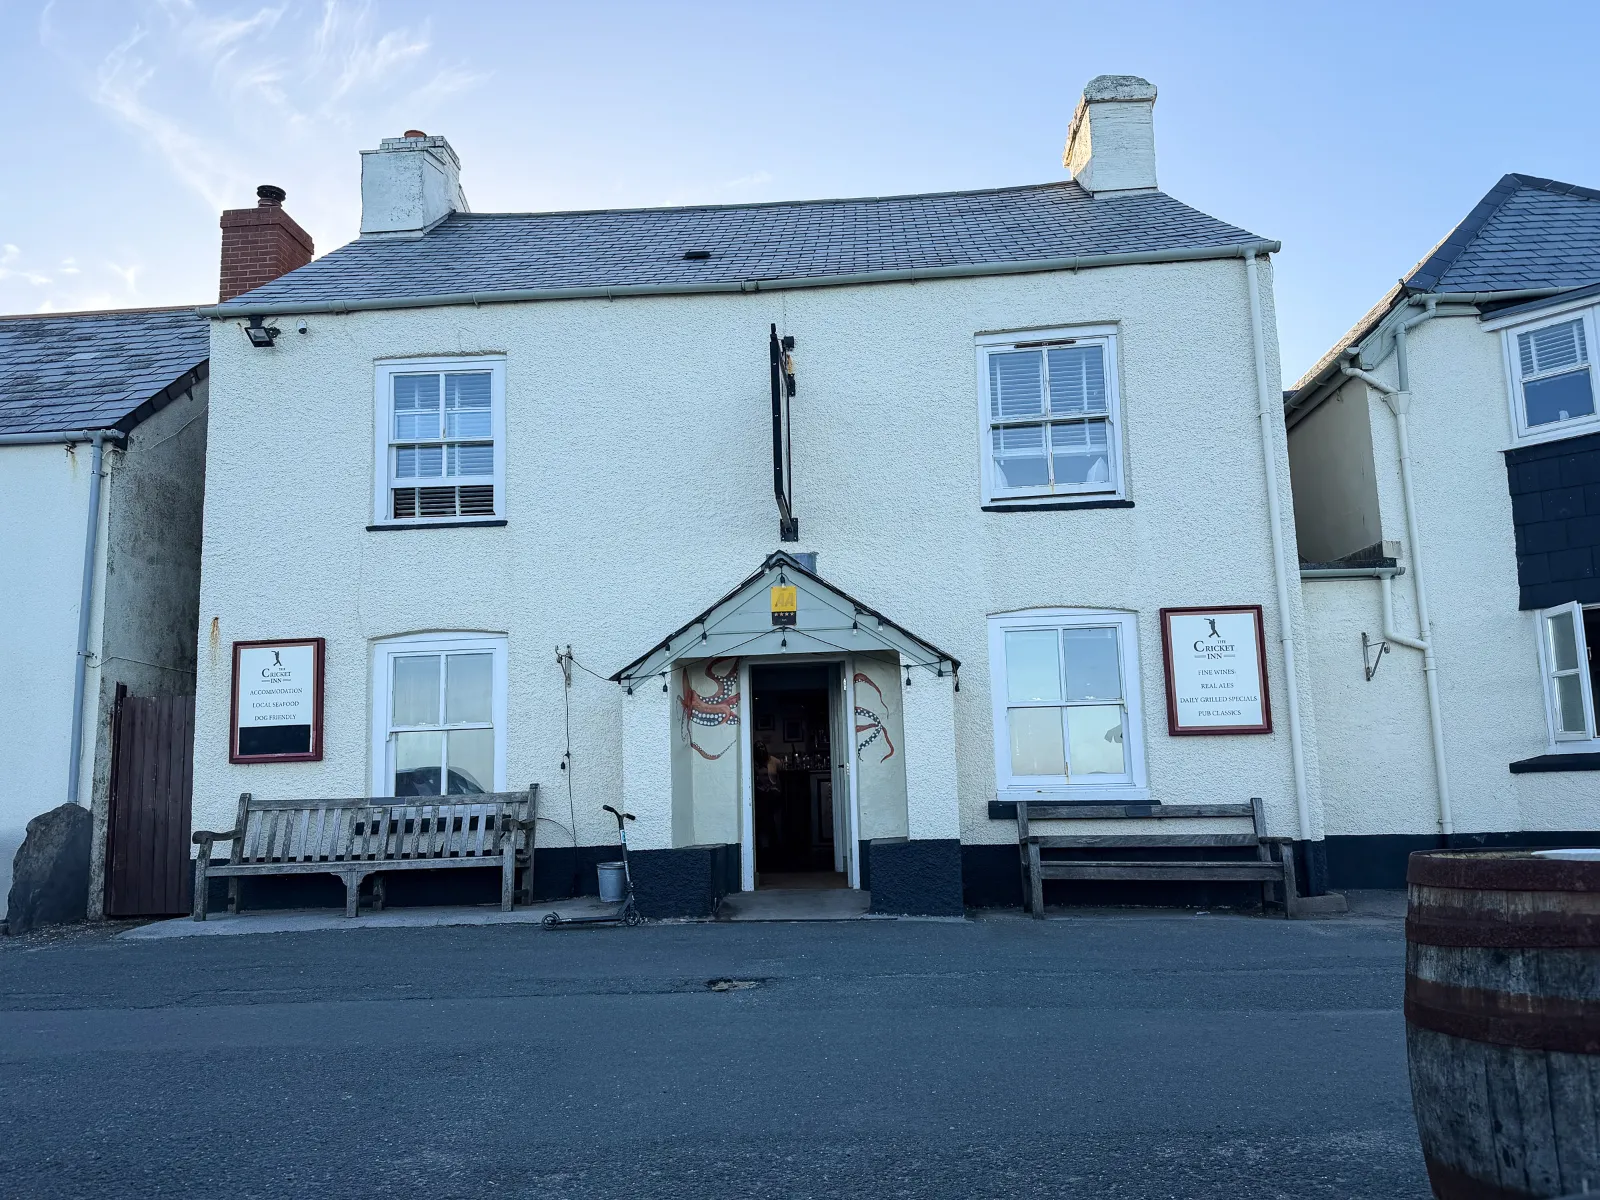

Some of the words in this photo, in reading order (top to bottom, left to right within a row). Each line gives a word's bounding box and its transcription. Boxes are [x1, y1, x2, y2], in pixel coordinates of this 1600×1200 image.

[775, 592, 794, 607] AA
[1193, 640, 1235, 652] CRICKET
[261, 668, 291, 678] CRICKET
